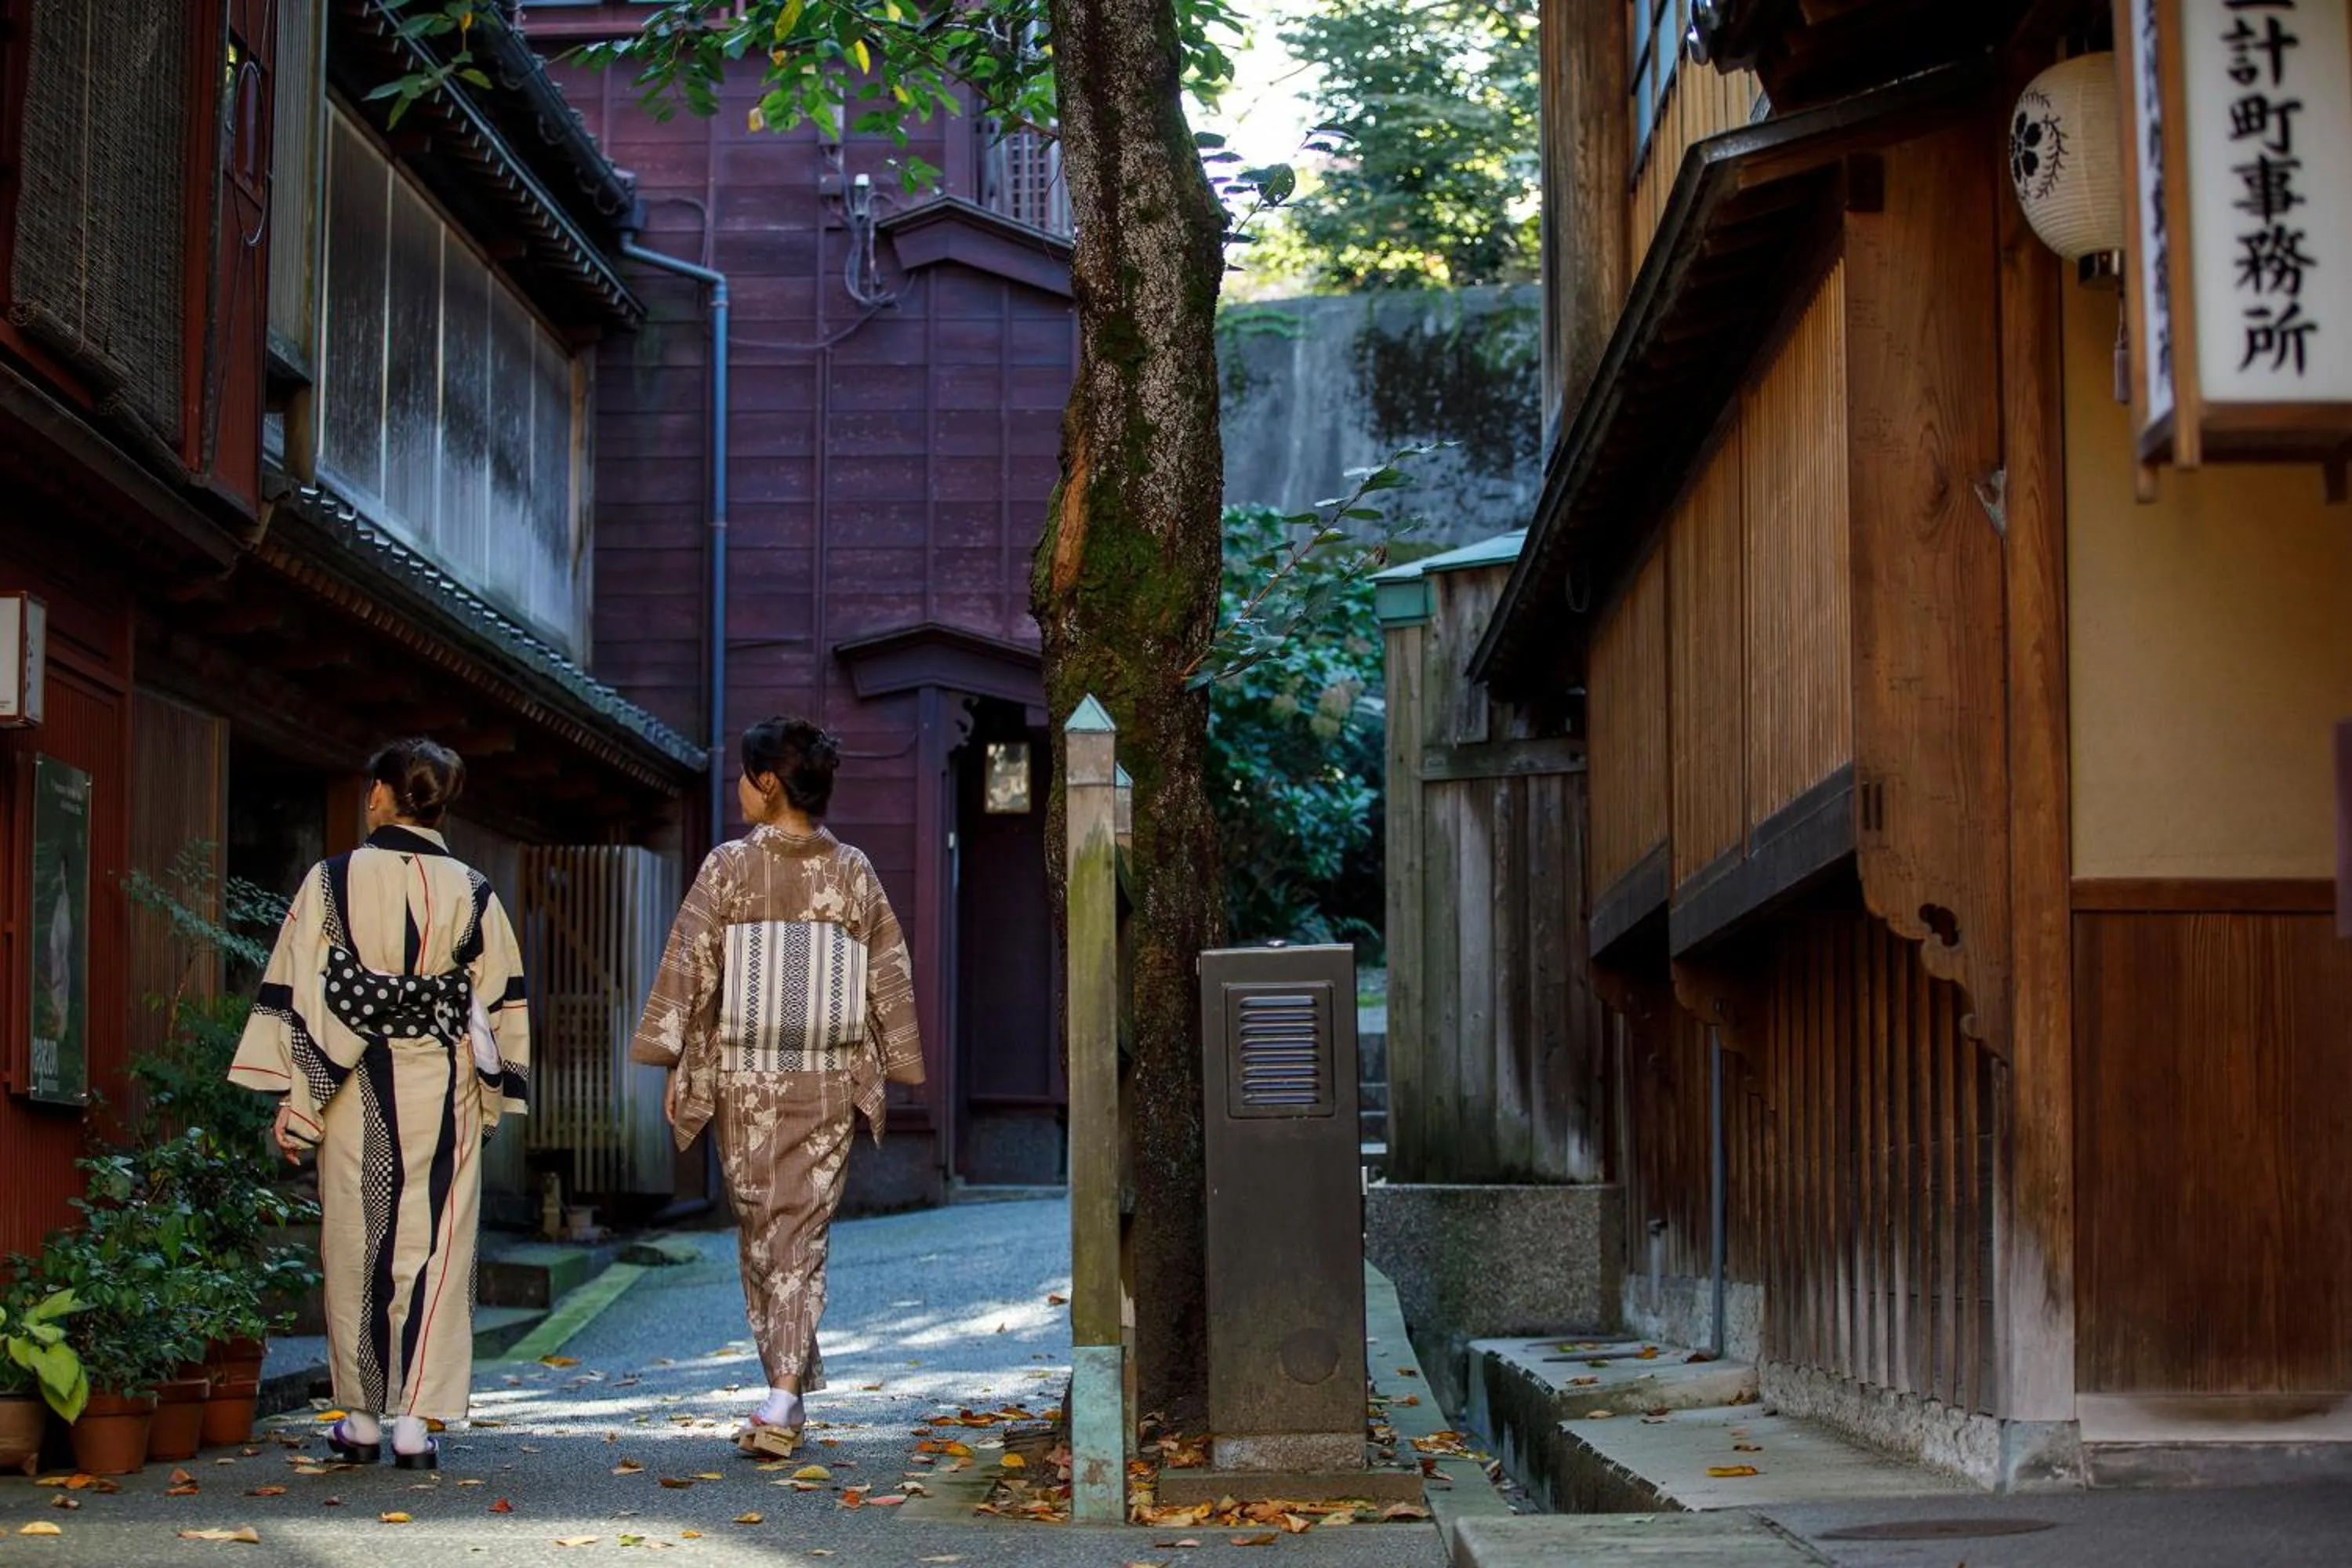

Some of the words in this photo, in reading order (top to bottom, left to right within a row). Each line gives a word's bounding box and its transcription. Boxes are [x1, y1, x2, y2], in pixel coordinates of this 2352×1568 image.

[2220, 0, 2318, 376] 計町事務所
